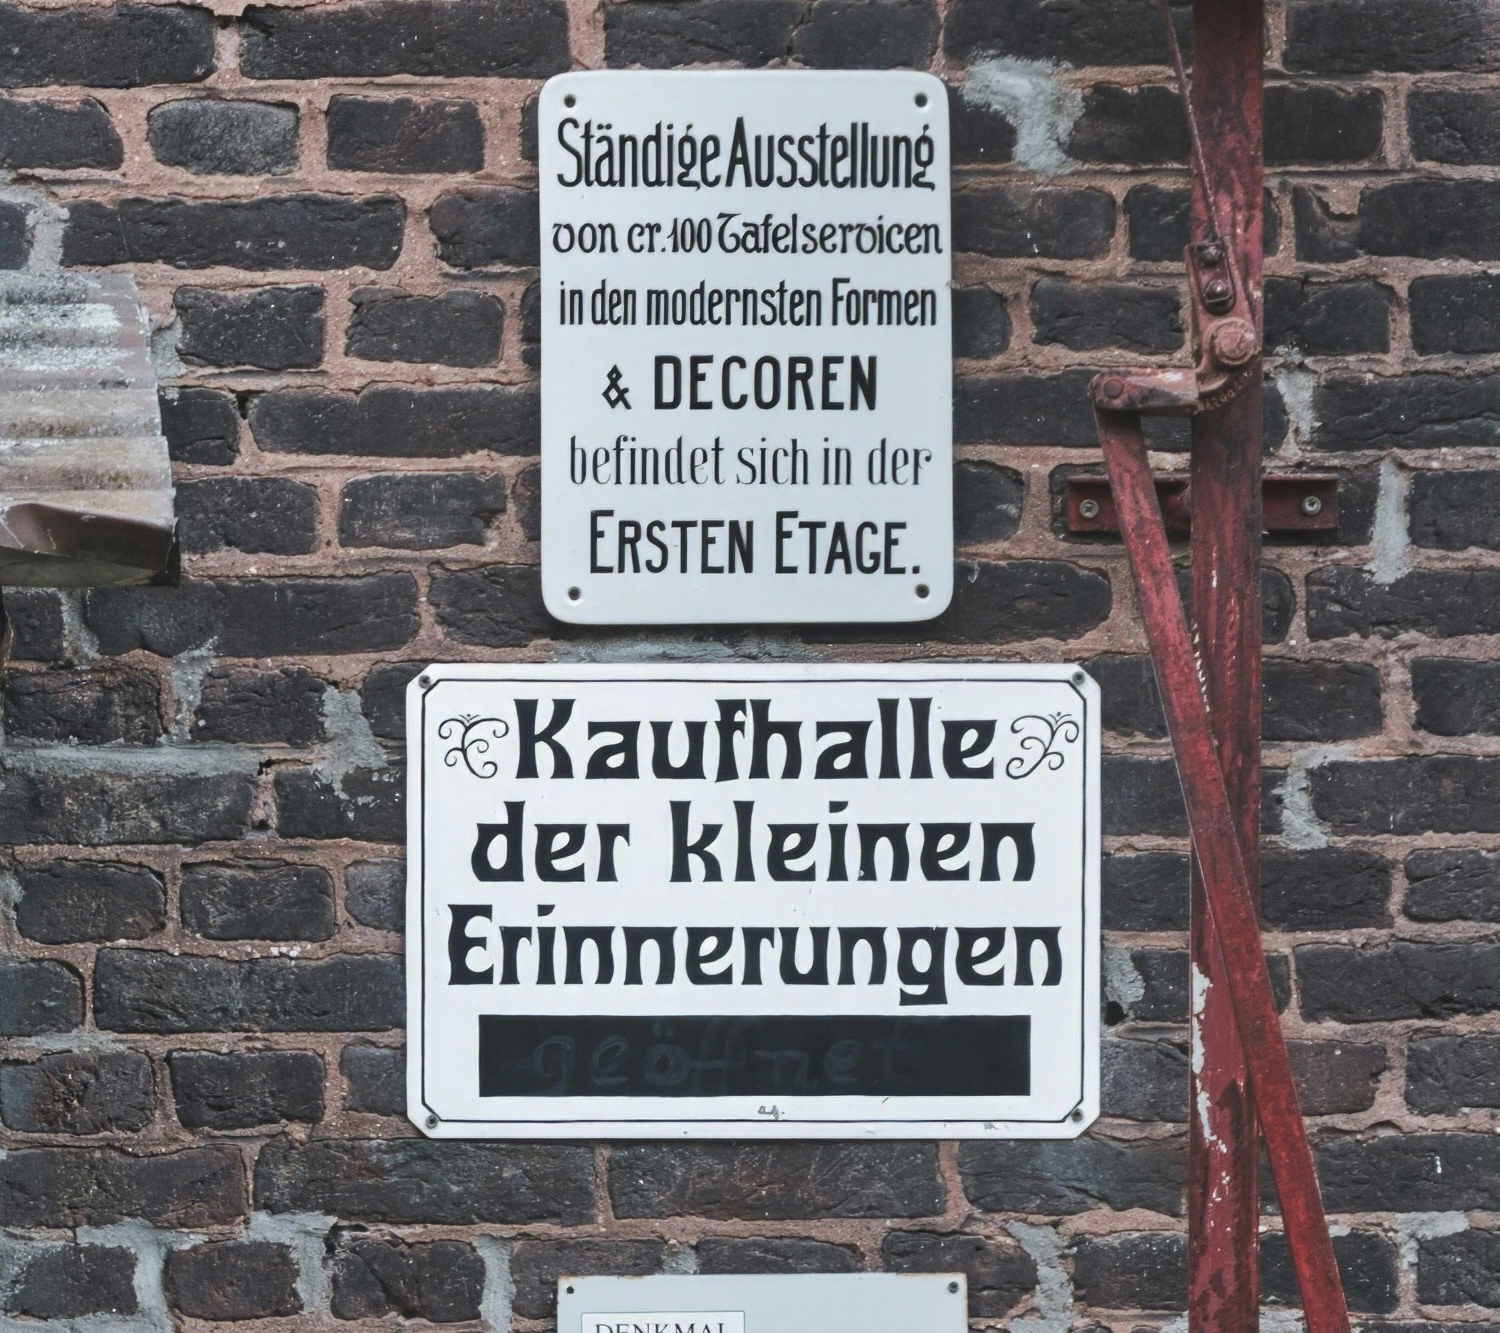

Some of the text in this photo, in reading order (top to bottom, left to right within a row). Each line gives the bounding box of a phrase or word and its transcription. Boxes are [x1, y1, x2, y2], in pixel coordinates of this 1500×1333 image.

[557, 116, 936, 192] Ständige Ausstellung
[552, 222, 619, 254] von
[717, 212, 943, 255] Tafelservicen
[559, 277, 937, 327] in den modernsten Formen
[601, 355, 878, 411] & DECOREN
[569, 436, 932, 486] befindet sich in der
[514, 697, 997, 782] Kaufhalle
[470, 800, 1036, 882] der kleinen
[448, 904, 1063, 1006] Erinnerungen
